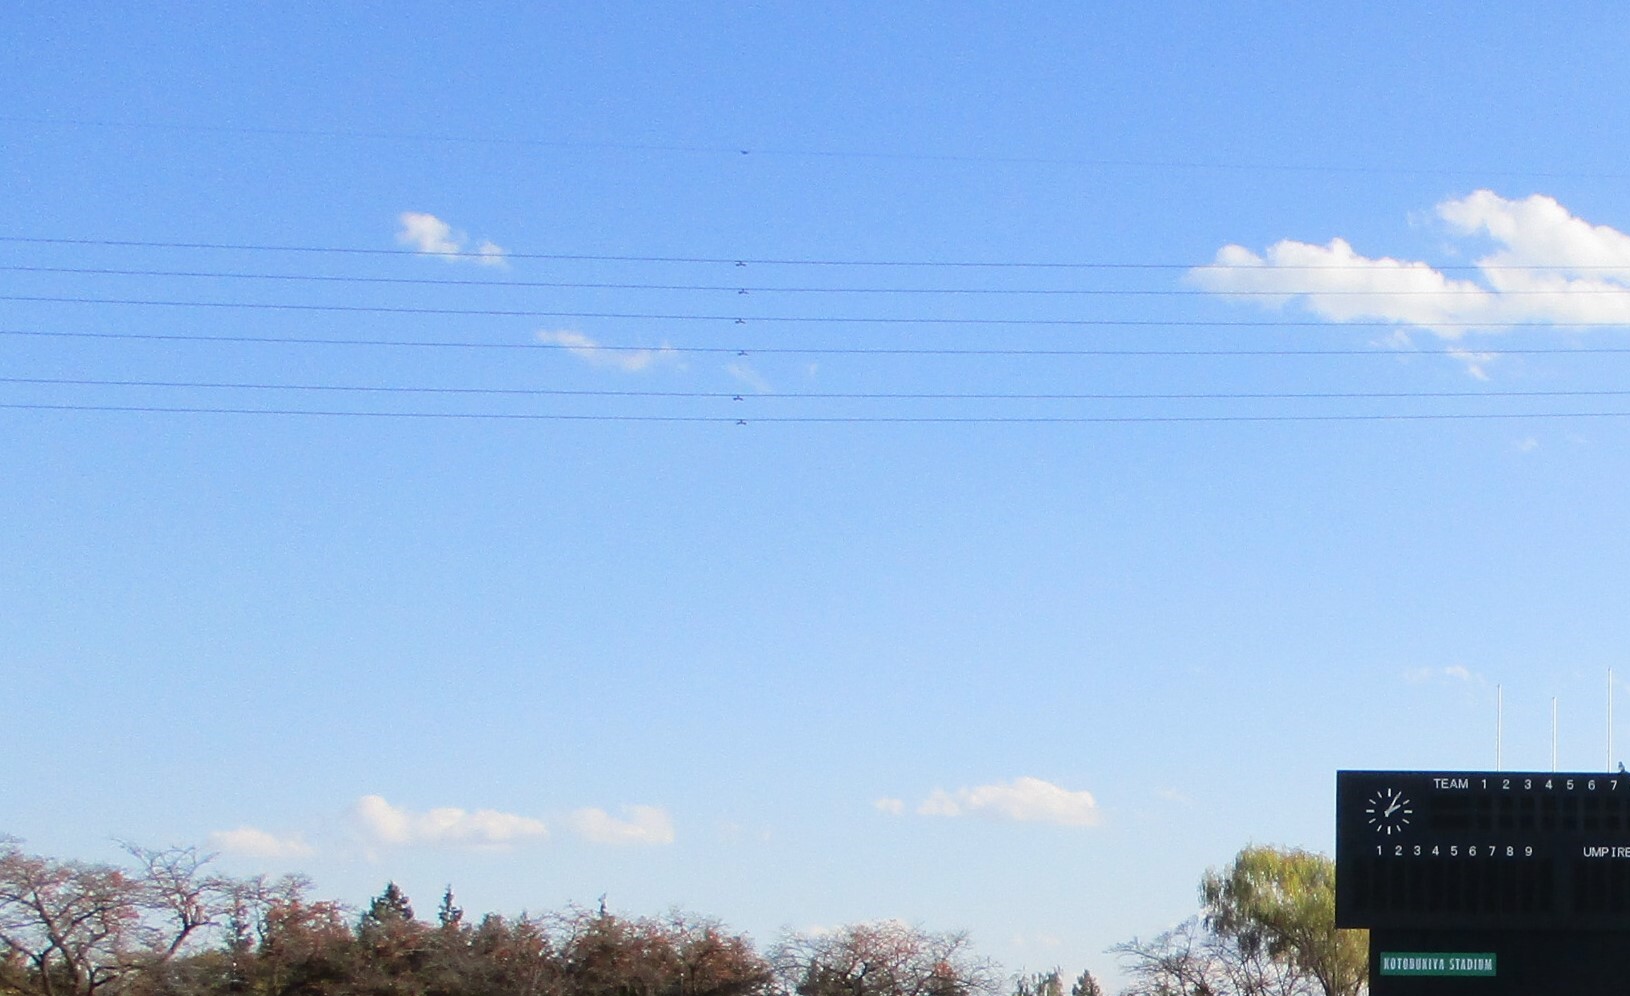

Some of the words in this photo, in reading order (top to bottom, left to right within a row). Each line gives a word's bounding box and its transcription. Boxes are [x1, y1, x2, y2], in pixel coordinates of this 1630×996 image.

[1433, 777, 1469, 789] TEAM
[1502, 778, 1510, 790] 2
[1524, 778, 1532, 790] 3
[1545, 779, 1553, 790] 4
[1566, 779, 1574, 791] 5
[1587, 779, 1596, 791] 6
[1610, 779, 1618, 791] 7
[1394, 844, 1403, 856] 2
[1413, 845, 1421, 856] 3
[1431, 845, 1440, 856] 4
[1450, 845, 1458, 857] 5
[1468, 845, 1477, 857] 6
[1488, 845, 1496, 857] 7
[1506, 845, 1514, 857] 8
[1524, 845, 1533, 857] 9
[1383, 957, 1445, 970] KOTOBUKIYA
[1449, 958, 1492, 971] STADIUM
